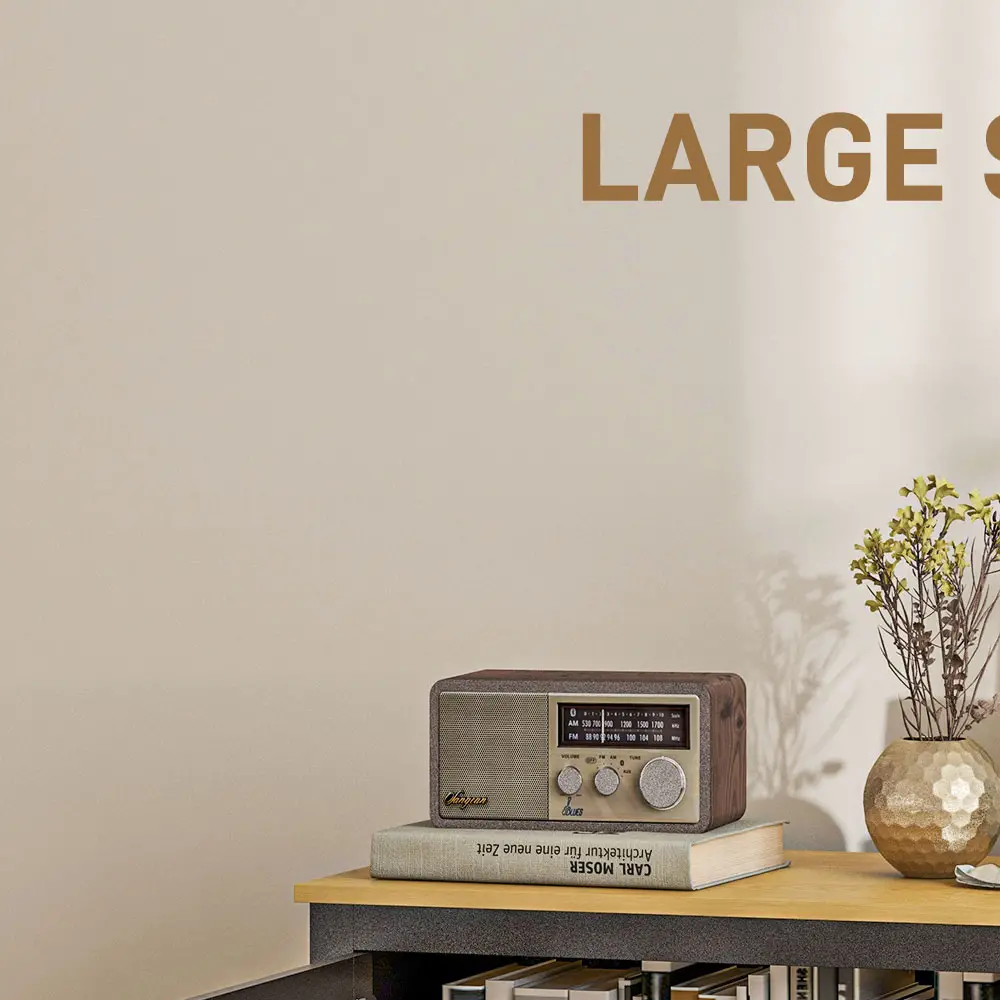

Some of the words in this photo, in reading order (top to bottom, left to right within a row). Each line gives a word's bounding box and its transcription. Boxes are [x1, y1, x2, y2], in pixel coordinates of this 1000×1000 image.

[567, 719, 580, 727] AM
[581, 719, 592, 728] 530
[620, 720, 633, 729] 1200
[637, 720, 649, 729] 1500
[651, 721, 665, 729] 1700
[585, 733, 592, 741] 88
[592, 733, 600, 741] 90
[606, 733, 613, 741] 94
[626, 733, 637, 742] 100
[639, 734, 649, 742] 104
[653, 734, 664, 742] 108
[477, 843, 500, 857] Zeit
[503, 844, 532, 855] neue
[536, 844, 561, 859] eine
[564, 846, 582, 860] für
[585, 847, 653, 862] Architektur
[570, 860, 614, 875] MOSER
[619, 862, 652, 876] CARL
